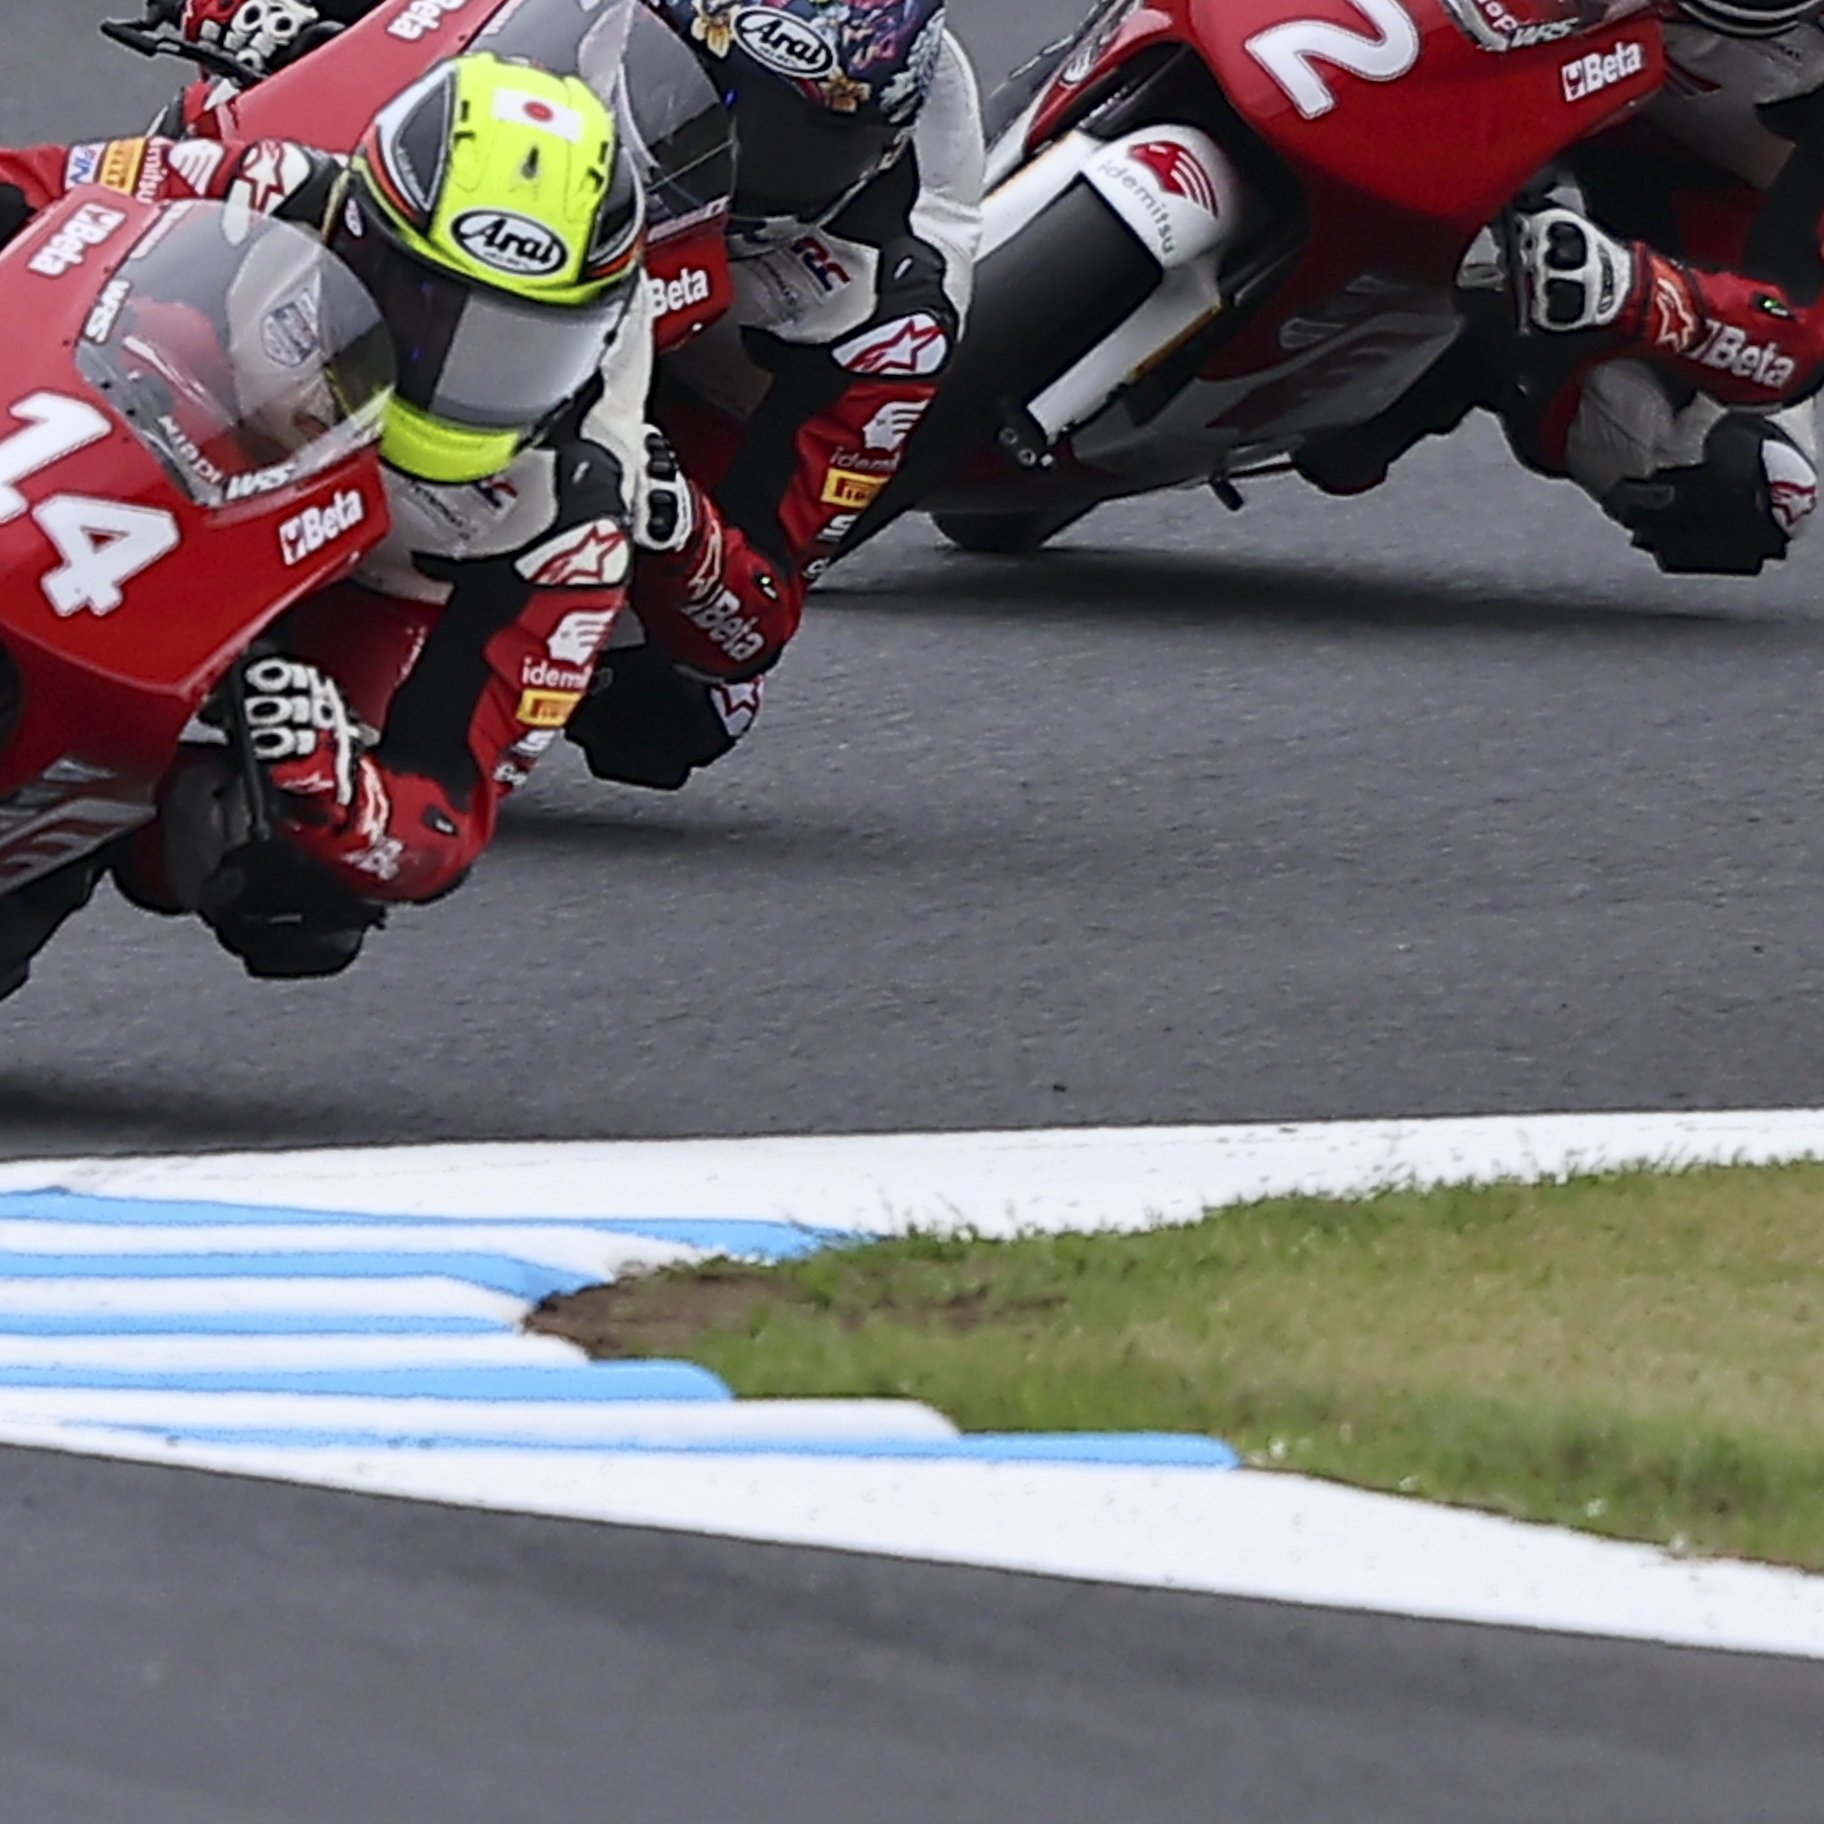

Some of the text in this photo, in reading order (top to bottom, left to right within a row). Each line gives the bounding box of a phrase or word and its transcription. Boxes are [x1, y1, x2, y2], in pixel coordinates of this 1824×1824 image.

[738, 19, 822, 64] Arai
[1587, 40, 1644, 96] Beta
[1098, 159, 1175, 257] idemitsu
[26, 214, 108, 279] Beta
[460, 217, 555, 264] Arai
[646, 267, 710, 319] Beta
[1707, 324, 1796, 389] Beta
[303, 487, 365, 550] Beta
[702, 590, 764, 664] Beta
